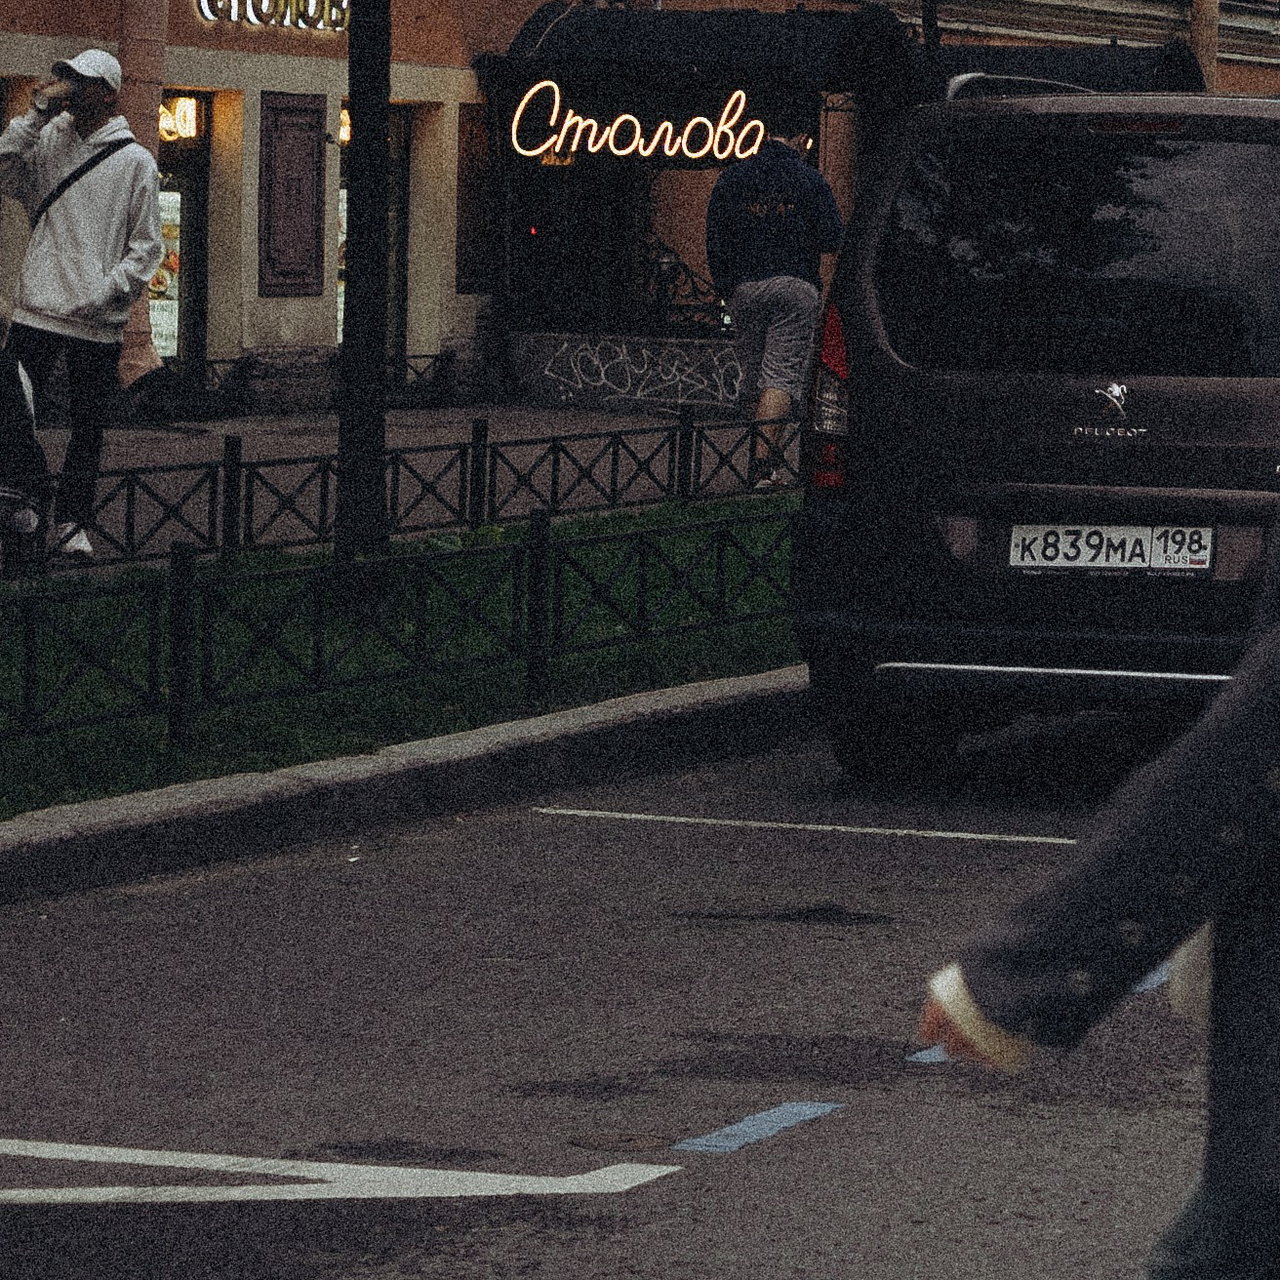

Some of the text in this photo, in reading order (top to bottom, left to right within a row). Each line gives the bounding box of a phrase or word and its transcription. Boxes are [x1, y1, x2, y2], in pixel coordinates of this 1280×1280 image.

[511, 80, 813, 160] Столова
[1155, 528, 1204, 555] 198
[1164, 554, 1189, 565] RUS
